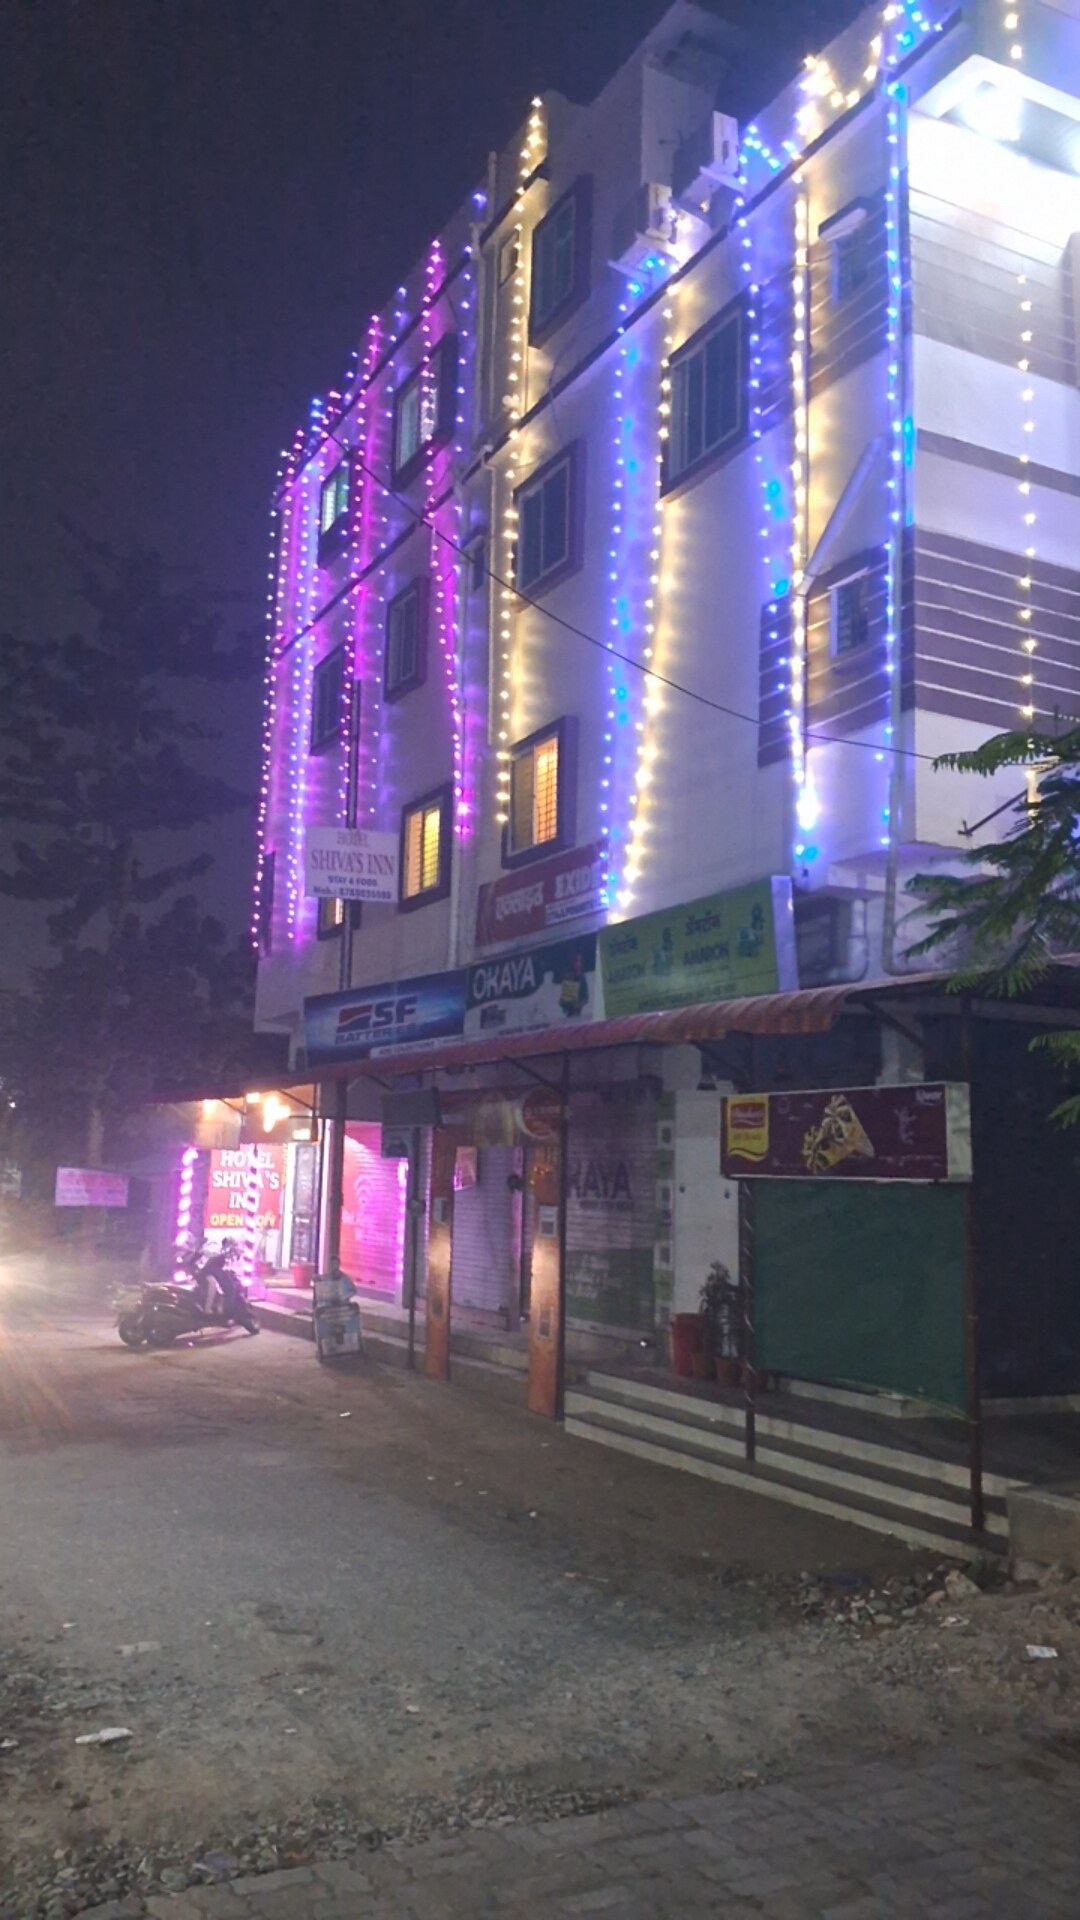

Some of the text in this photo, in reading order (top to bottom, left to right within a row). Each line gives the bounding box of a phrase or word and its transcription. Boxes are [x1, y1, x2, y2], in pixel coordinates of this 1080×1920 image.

[312, 849, 394, 876] SHIVA'S INN
[327, 875, 347, 885] STAY
[356, 878, 378, 887] FOOD
[473, 956, 536, 999] OKAYA
[372, 995, 417, 1028] SF
[210, 1213, 244, 1227] OPEN
